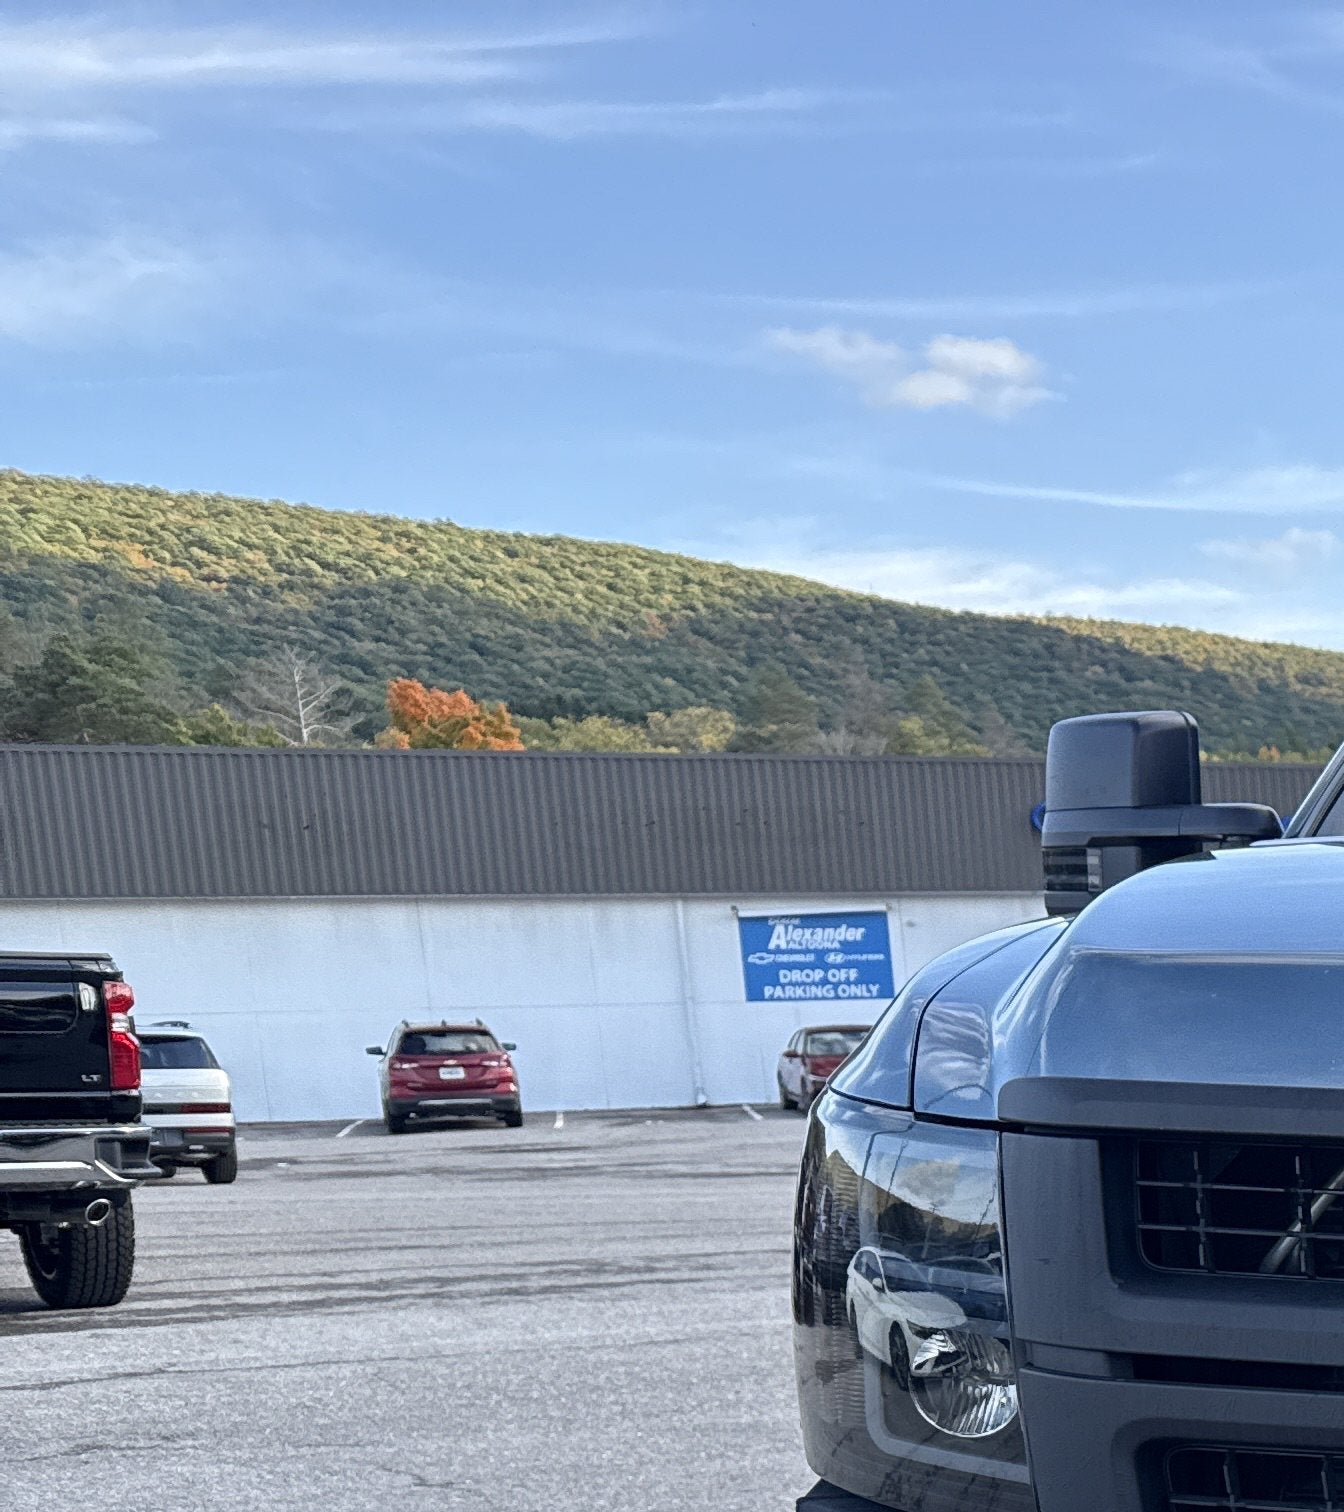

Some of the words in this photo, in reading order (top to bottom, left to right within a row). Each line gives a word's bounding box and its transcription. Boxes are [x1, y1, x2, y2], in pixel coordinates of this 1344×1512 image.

[768, 923, 866, 950] Alexander
[779, 969, 824, 983] DROP
[827, 968, 858, 982] OFF
[764, 984, 835, 999] PARKING
[837, 983, 879, 998] ONLY
[81, 1074, 102, 1082] LT
